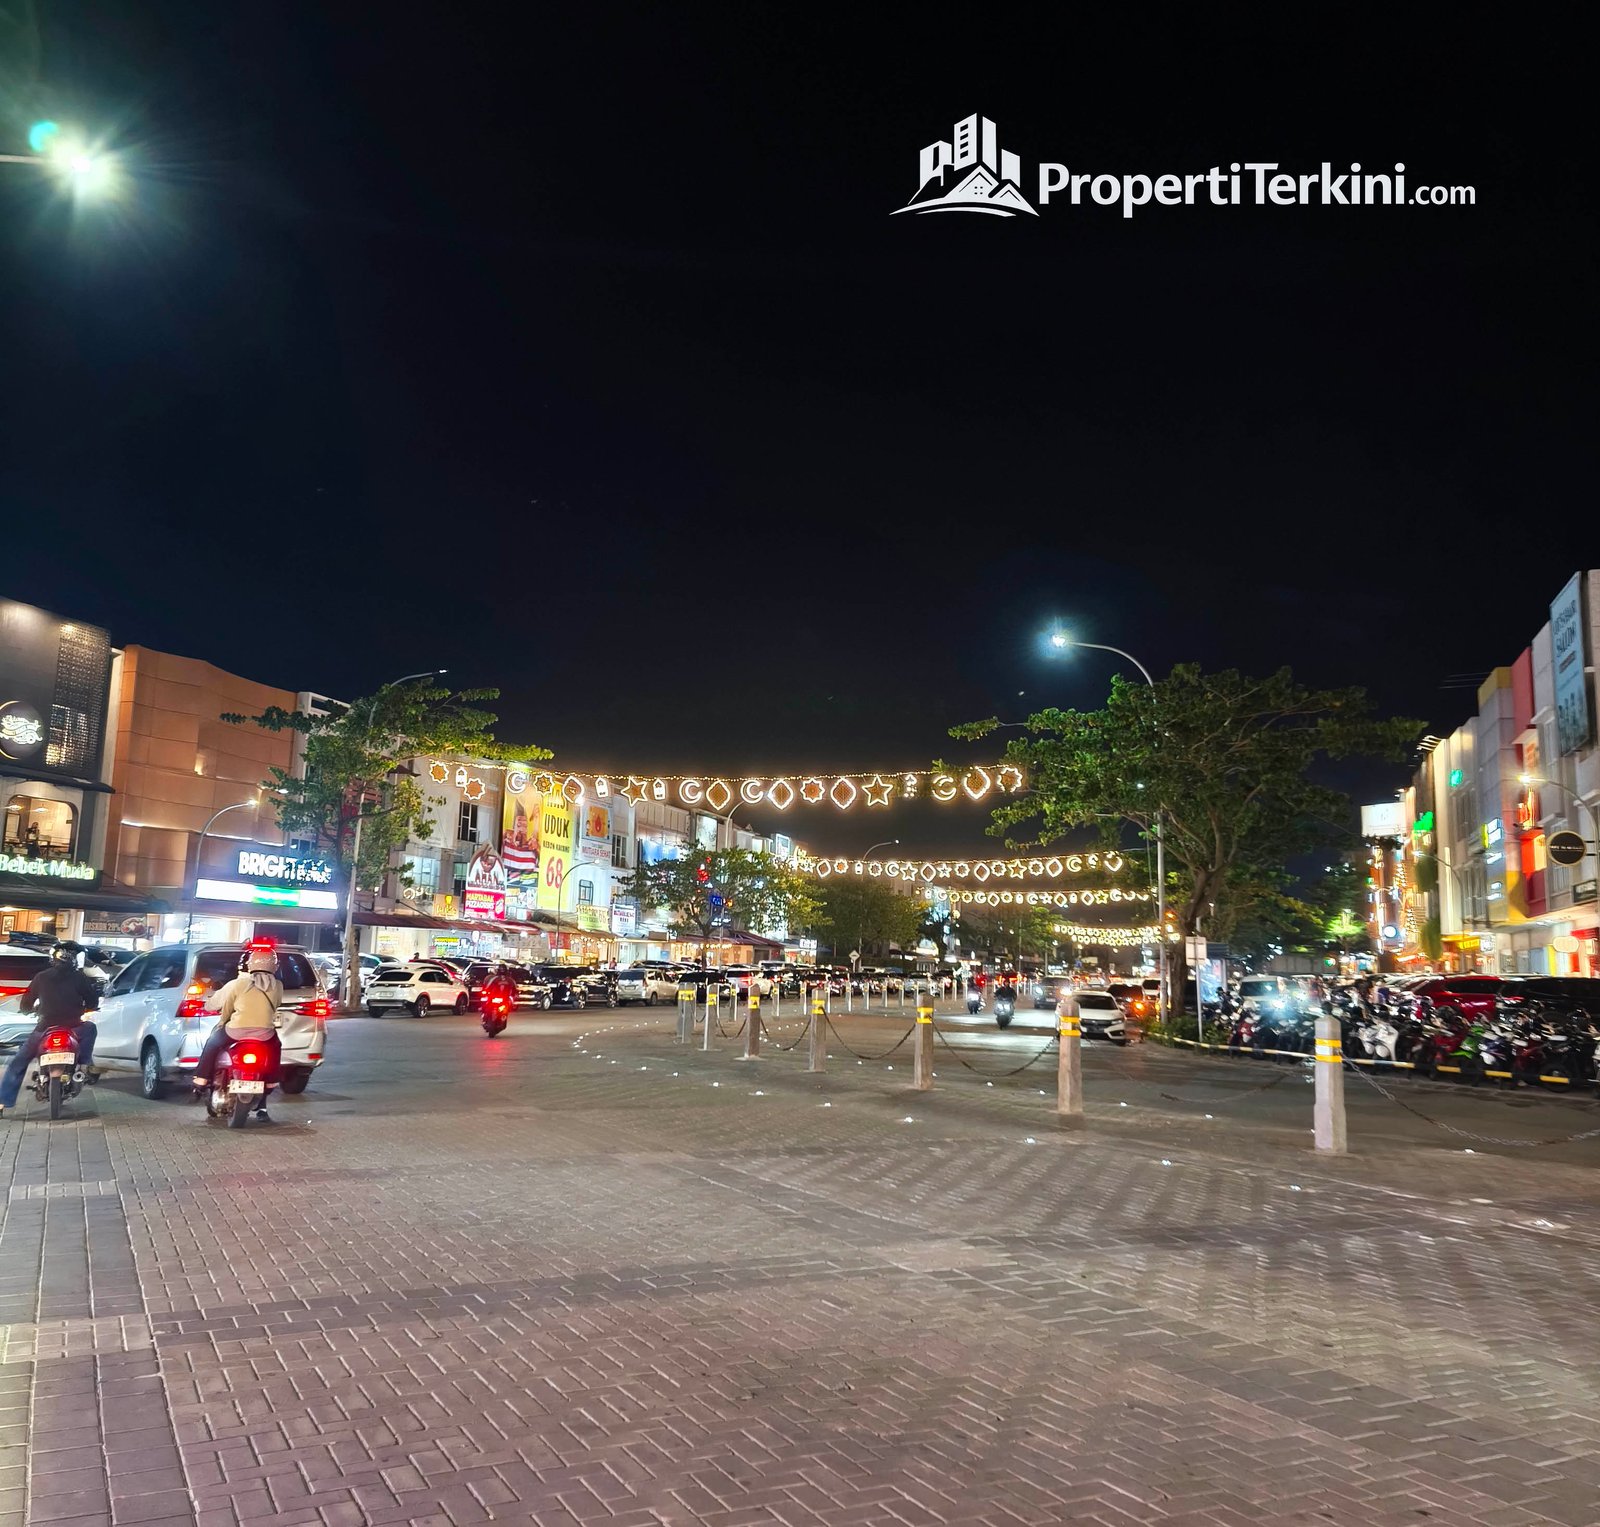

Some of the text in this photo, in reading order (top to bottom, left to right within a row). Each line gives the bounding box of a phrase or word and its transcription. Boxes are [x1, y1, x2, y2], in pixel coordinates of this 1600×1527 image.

[544, 813, 570, 839] UDUK
[0, 854, 95, 880] Bebek Muda
[546, 856, 564, 889] 68
